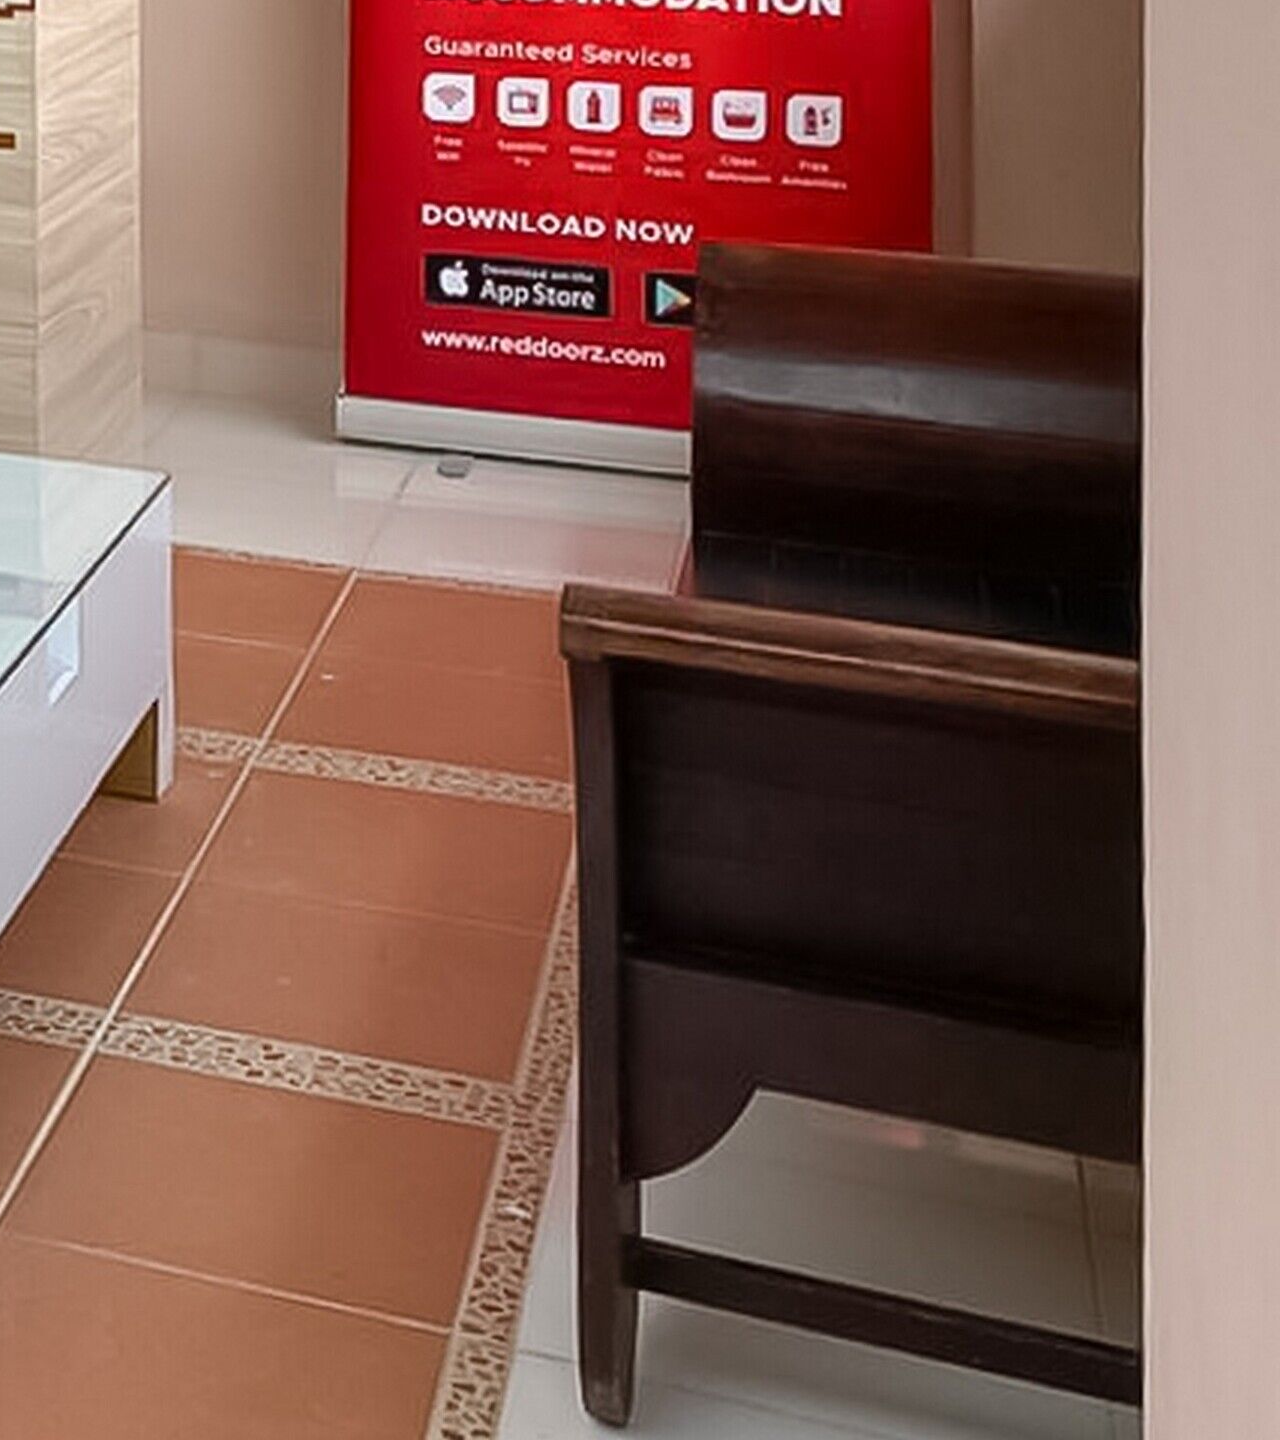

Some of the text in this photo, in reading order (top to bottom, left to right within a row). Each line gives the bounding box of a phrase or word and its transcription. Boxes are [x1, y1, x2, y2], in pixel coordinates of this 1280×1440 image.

[423, 36, 694, 70] Guaranteed Services
[421, 203, 694, 245] DOWNLOAD NOW
[479, 280, 596, 311] App Store
[421, 330, 666, 370] www.reddoorz.com
